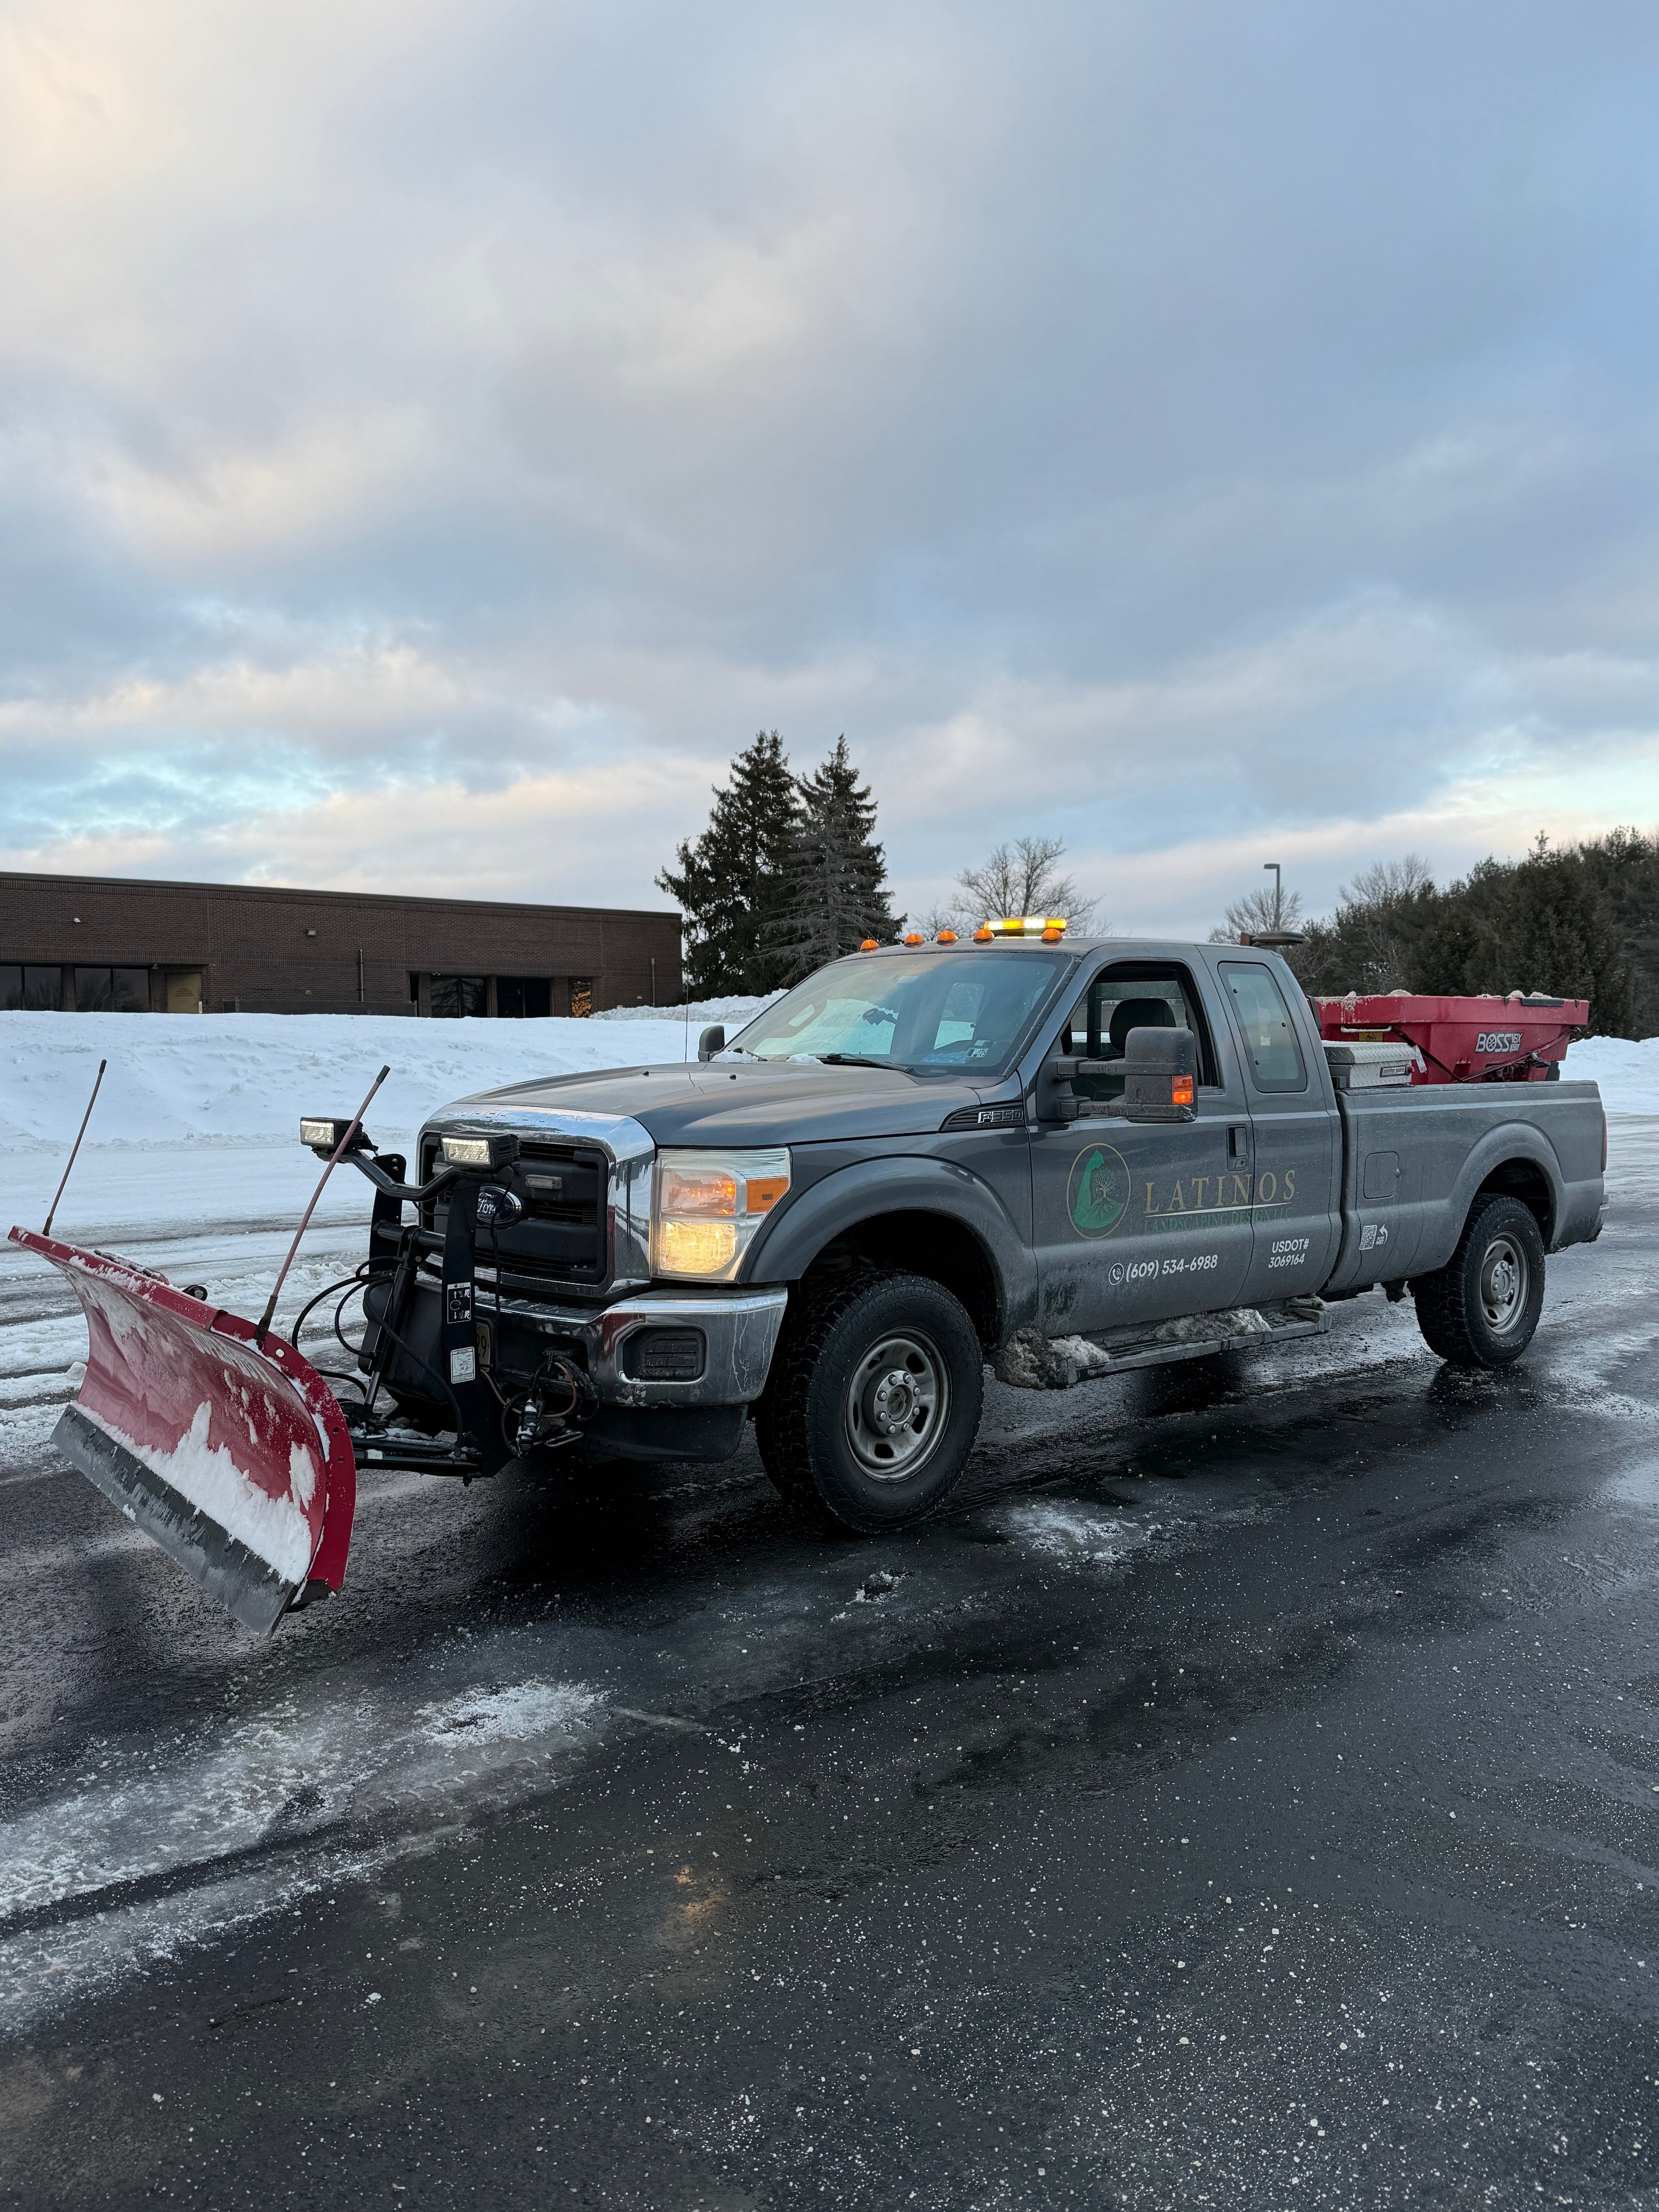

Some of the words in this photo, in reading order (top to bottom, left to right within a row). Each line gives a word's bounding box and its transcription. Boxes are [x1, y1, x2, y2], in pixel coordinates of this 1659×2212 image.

[1475, 1033, 1512, 1052] BOSS
[978, 1109, 1023, 1123] F-350
[1143, 1170, 1295, 1214] LATINOS
[477, 1192, 502, 1216] For
[1144, 1211, 1227, 1233] LANDSCAPING
[1232, 1209, 1271, 1224] DESIGN
[1274, 1207, 1293, 1221] LLC
[1272, 1238, 1309, 1253] USDOT#
[1126, 1260, 1159, 1282] (609)
[1162, 1255, 1218, 1275] 534-6988
[1268, 1253, 1305, 1268] 3069164
